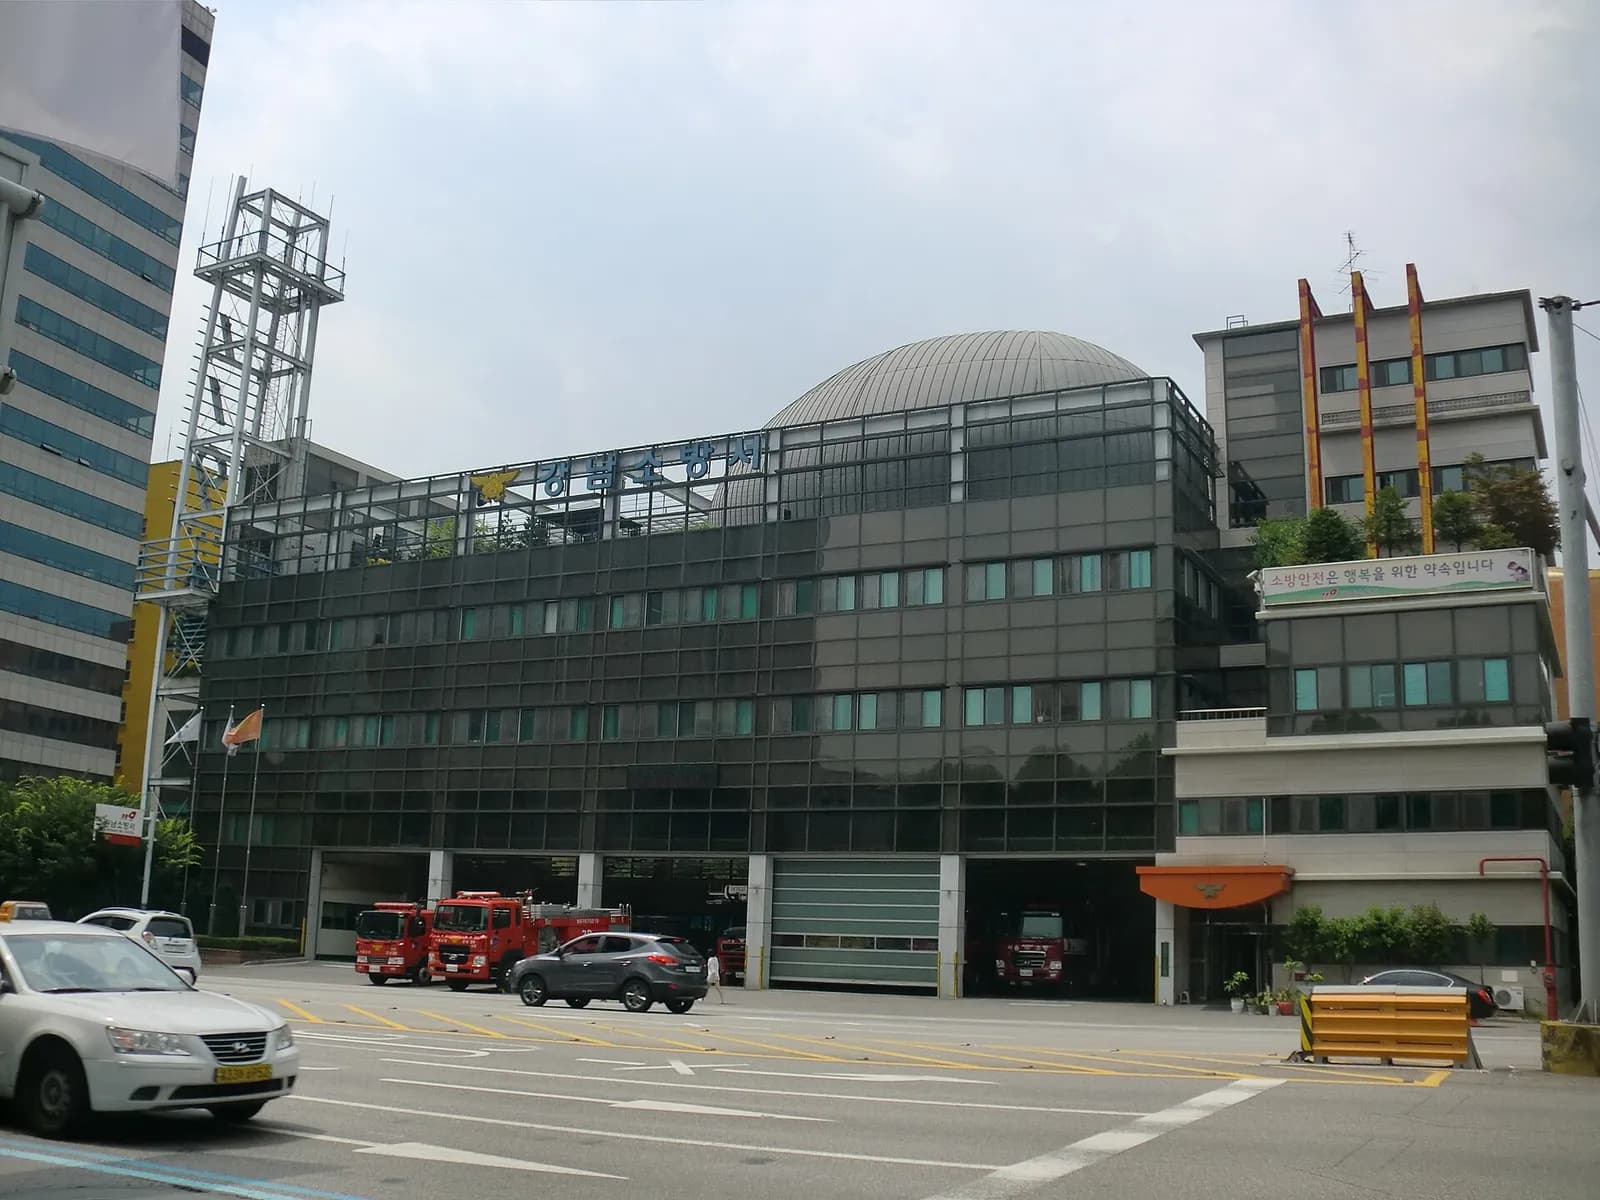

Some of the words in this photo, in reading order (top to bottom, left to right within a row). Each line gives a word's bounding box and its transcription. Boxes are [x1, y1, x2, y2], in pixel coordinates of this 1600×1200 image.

[538, 435, 762, 496] 강남소방서
[1272, 570, 1339, 586] 소방안전은
[1344, 567, 1385, 583] 행복을
[1391, 564, 1418, 579] 위한
[1423, 558, 1494, 576] 약속입니다
